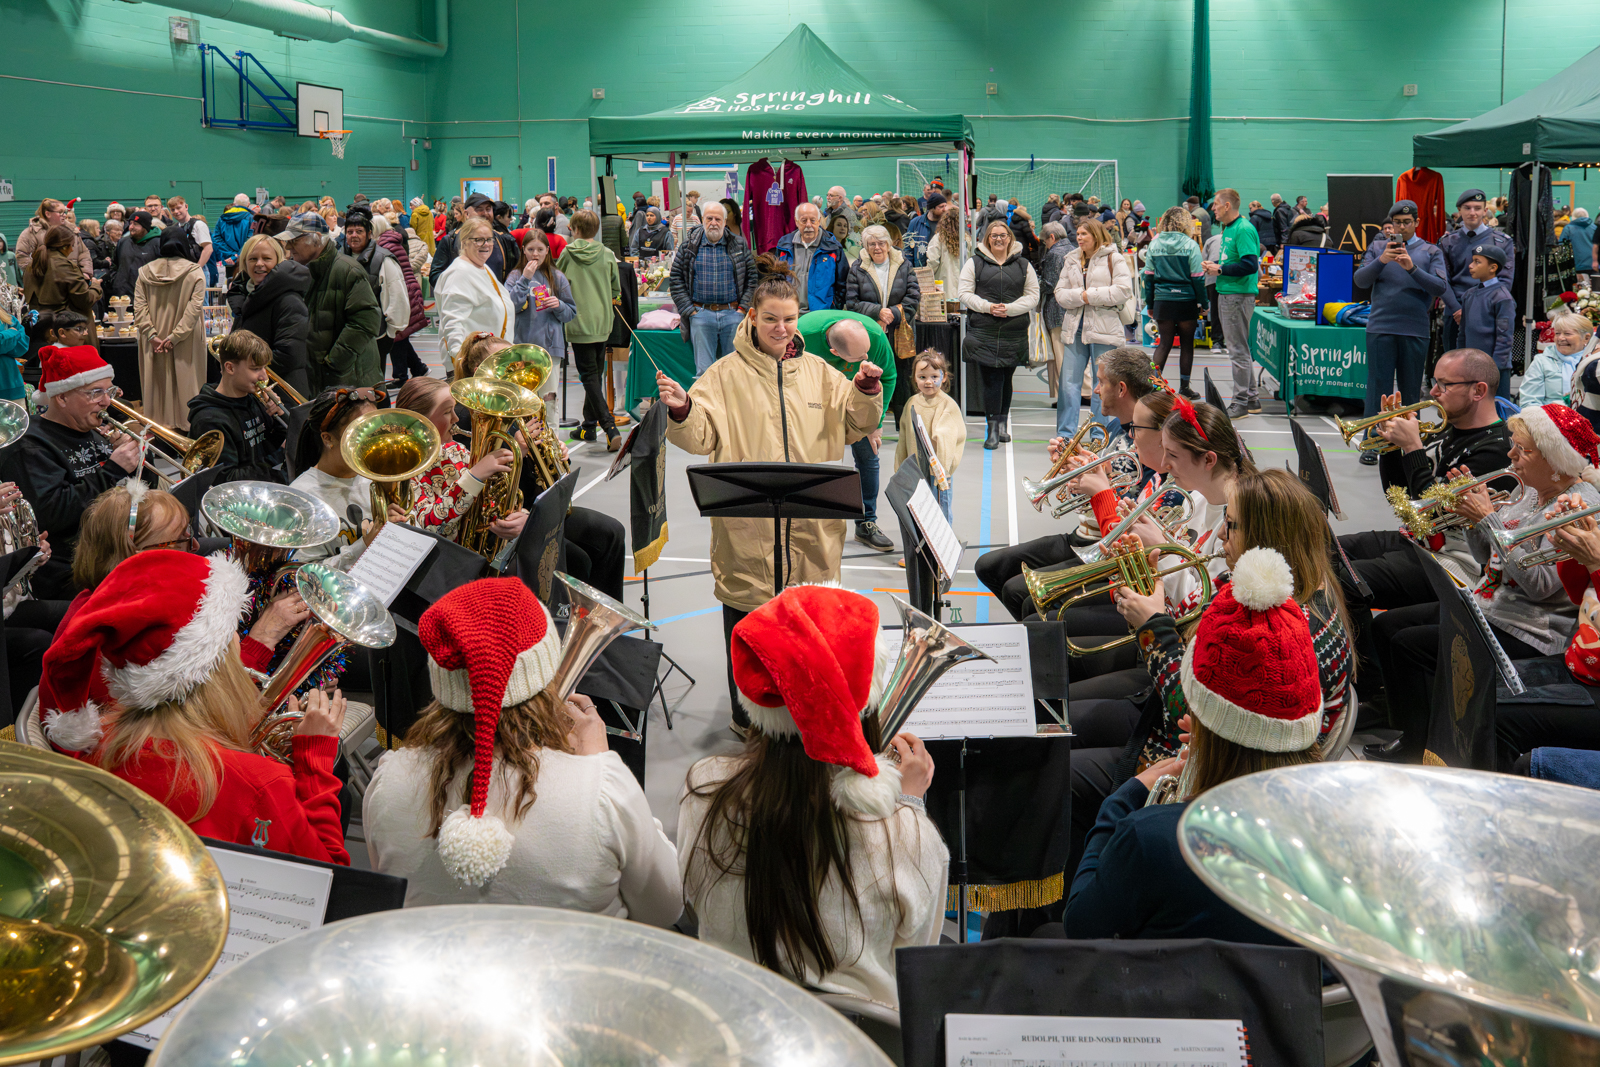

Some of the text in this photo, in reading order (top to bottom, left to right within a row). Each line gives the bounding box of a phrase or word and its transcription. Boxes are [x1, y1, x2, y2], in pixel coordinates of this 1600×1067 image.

[733, 89, 871, 106] Springhill
[742, 130, 791, 140] Making
[1301, 343, 1367, 370] Springhi
[1301, 363, 1343, 380] Hospice
[1304, 379, 1324, 387] every
[1326, 380, 1354, 388] moment
[1078, 1036, 1121, 1044] RED-NOSED
